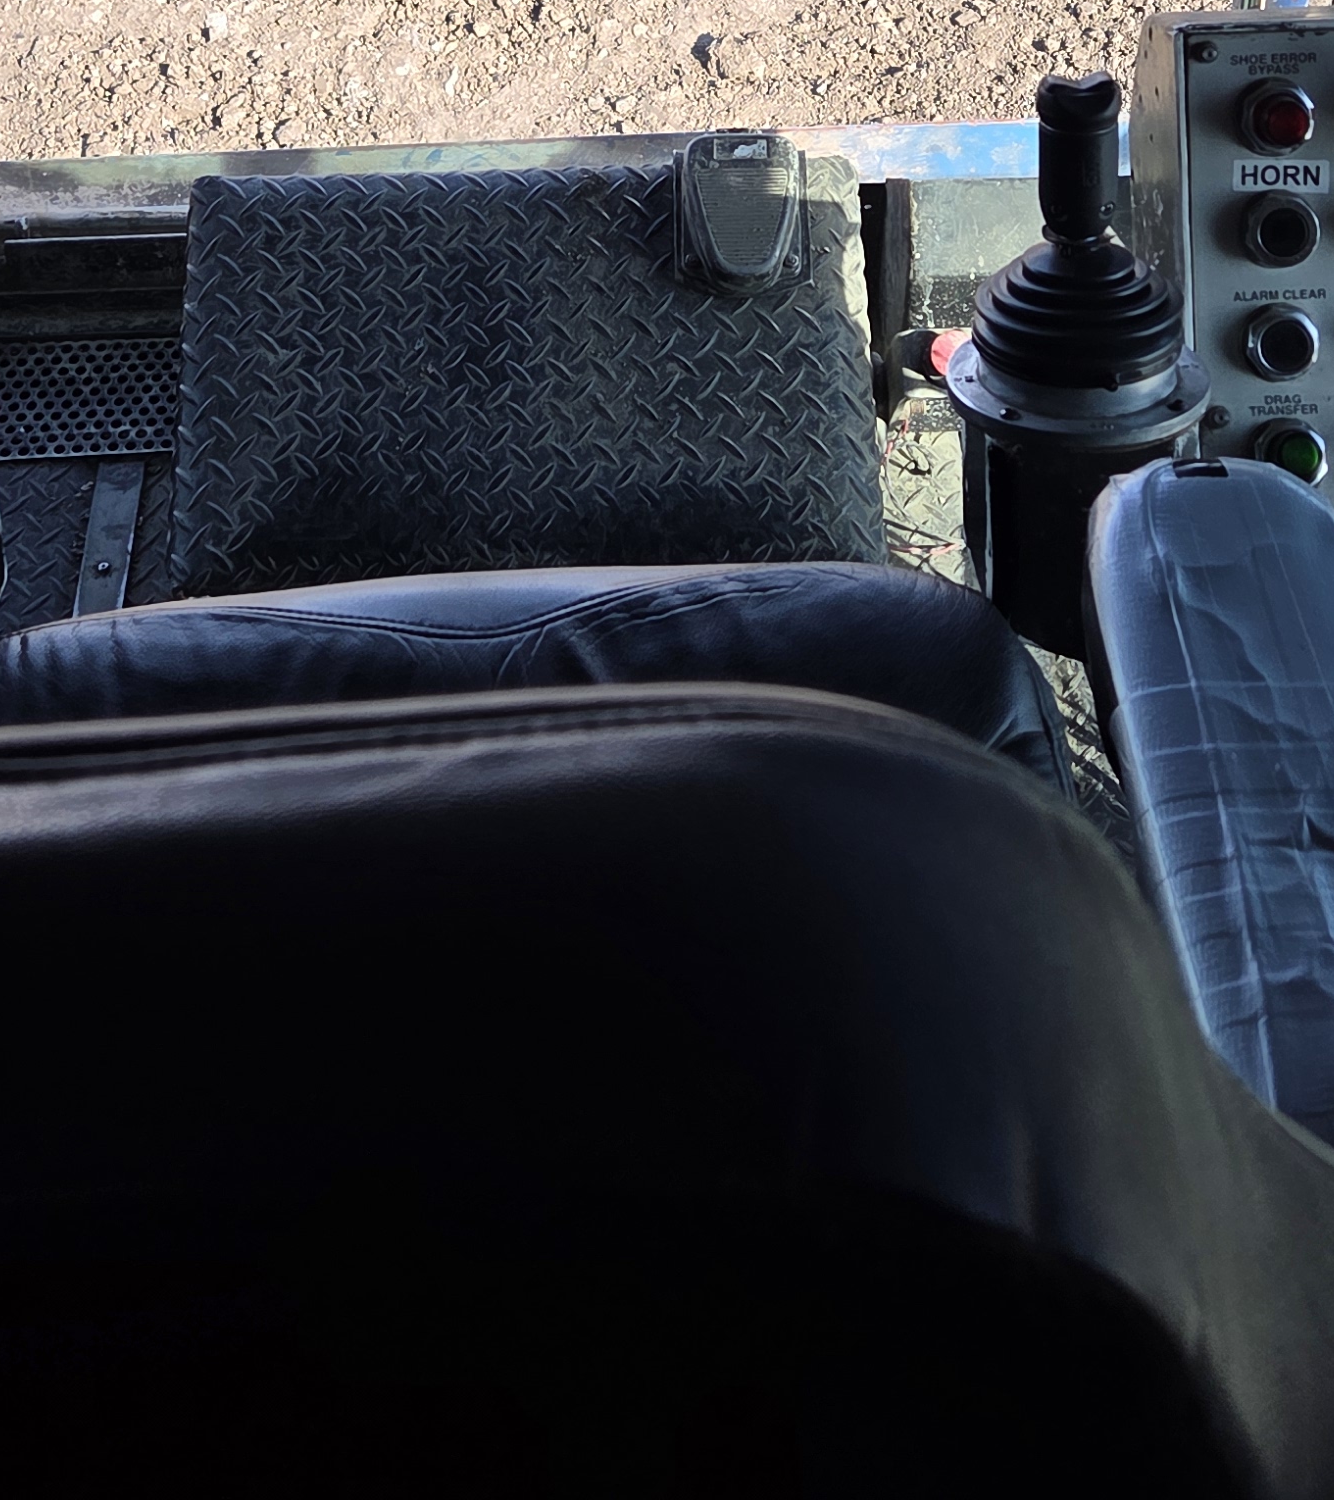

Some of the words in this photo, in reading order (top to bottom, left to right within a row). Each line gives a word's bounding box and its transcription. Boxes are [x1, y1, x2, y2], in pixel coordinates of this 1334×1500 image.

[1229, 53, 1269, 67] SHOE
[1271, 51, 1317, 64] ERROR
[1248, 63, 1300, 77] BYPASS
[1240, 164, 1321, 186] HORN
[1233, 290, 1279, 302] ALARM
[1282, 288, 1327, 300] CLEAR
[1264, 394, 1302, 406] DRAG
[1249, 404, 1319, 417] TRANSFER
